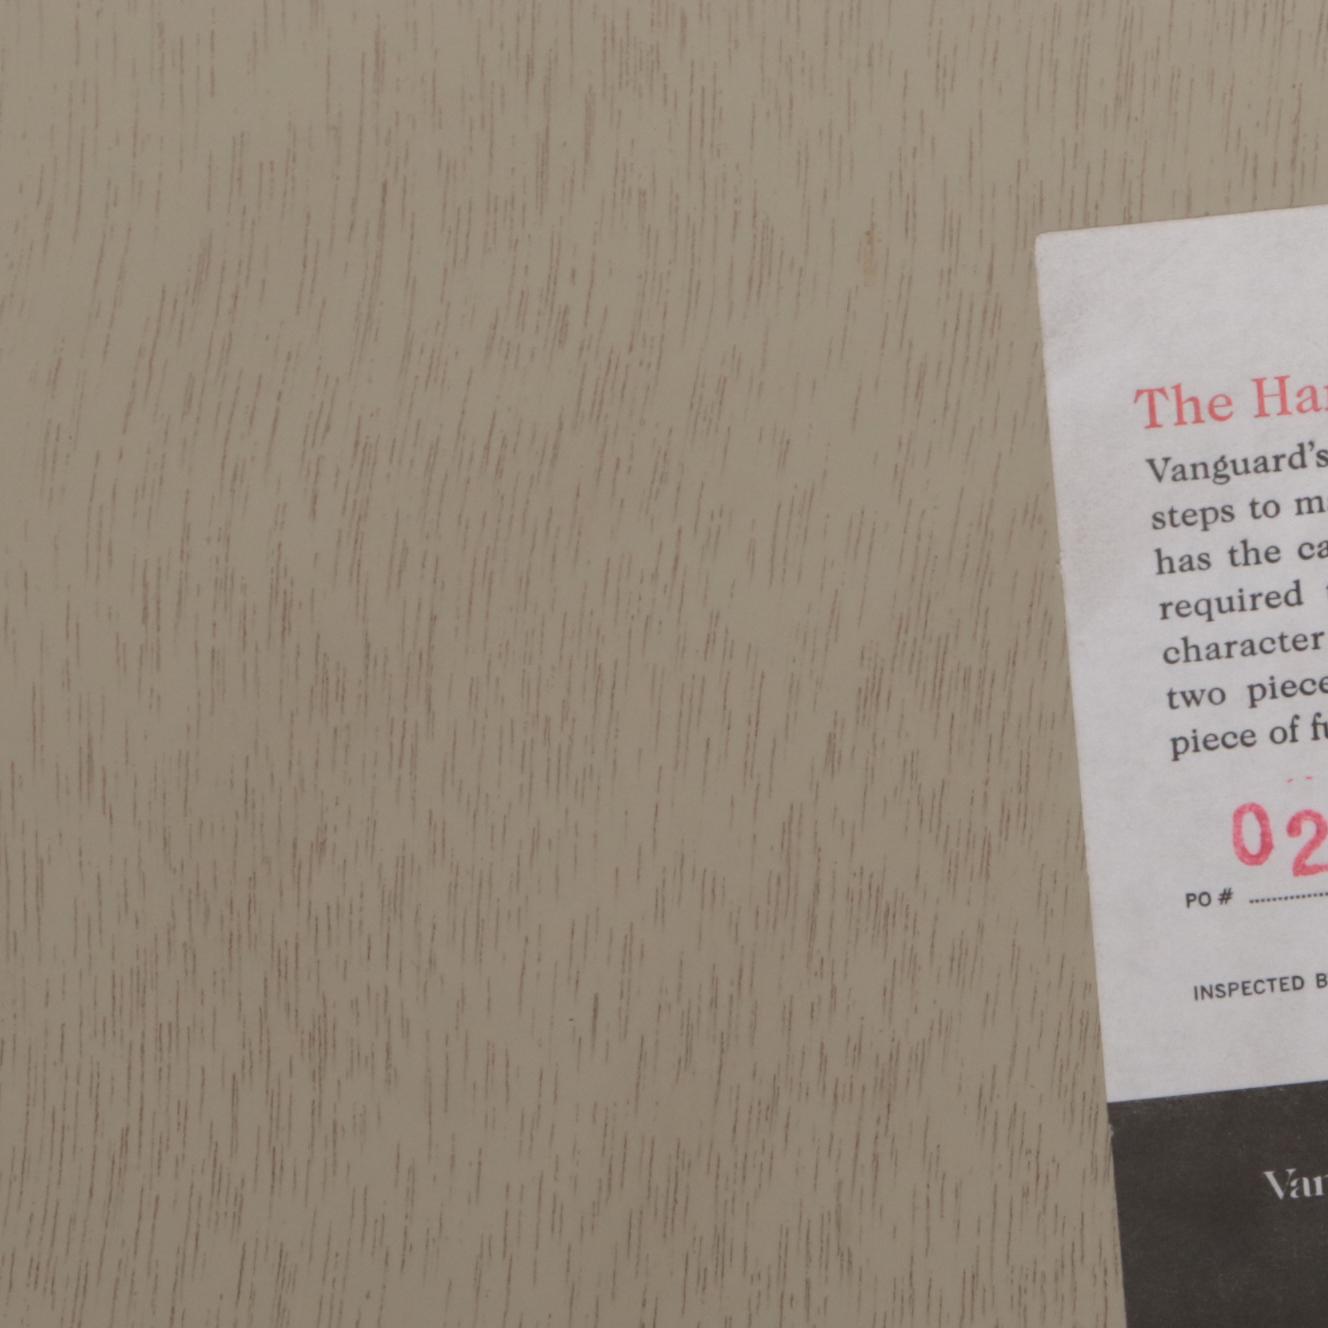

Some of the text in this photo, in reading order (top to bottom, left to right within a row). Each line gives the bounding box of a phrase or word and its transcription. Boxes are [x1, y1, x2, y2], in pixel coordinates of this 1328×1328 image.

[1135, 383, 1233, 430] The
[1152, 505, 1234, 531] steps
[1250, 500, 1280, 519] to
[1155, 548, 1211, 574] has
[1229, 539, 1280, 566] the
[1160, 580, 1303, 622] required
[1163, 632, 1324, 664] character
[1168, 688, 1225, 709] two
[1171, 729, 1256, 761] piece
[1270, 715, 1300, 744] of
[1186, 888, 1232, 908] PO #
[1194, 976, 1304, 1000] INSPECTED
